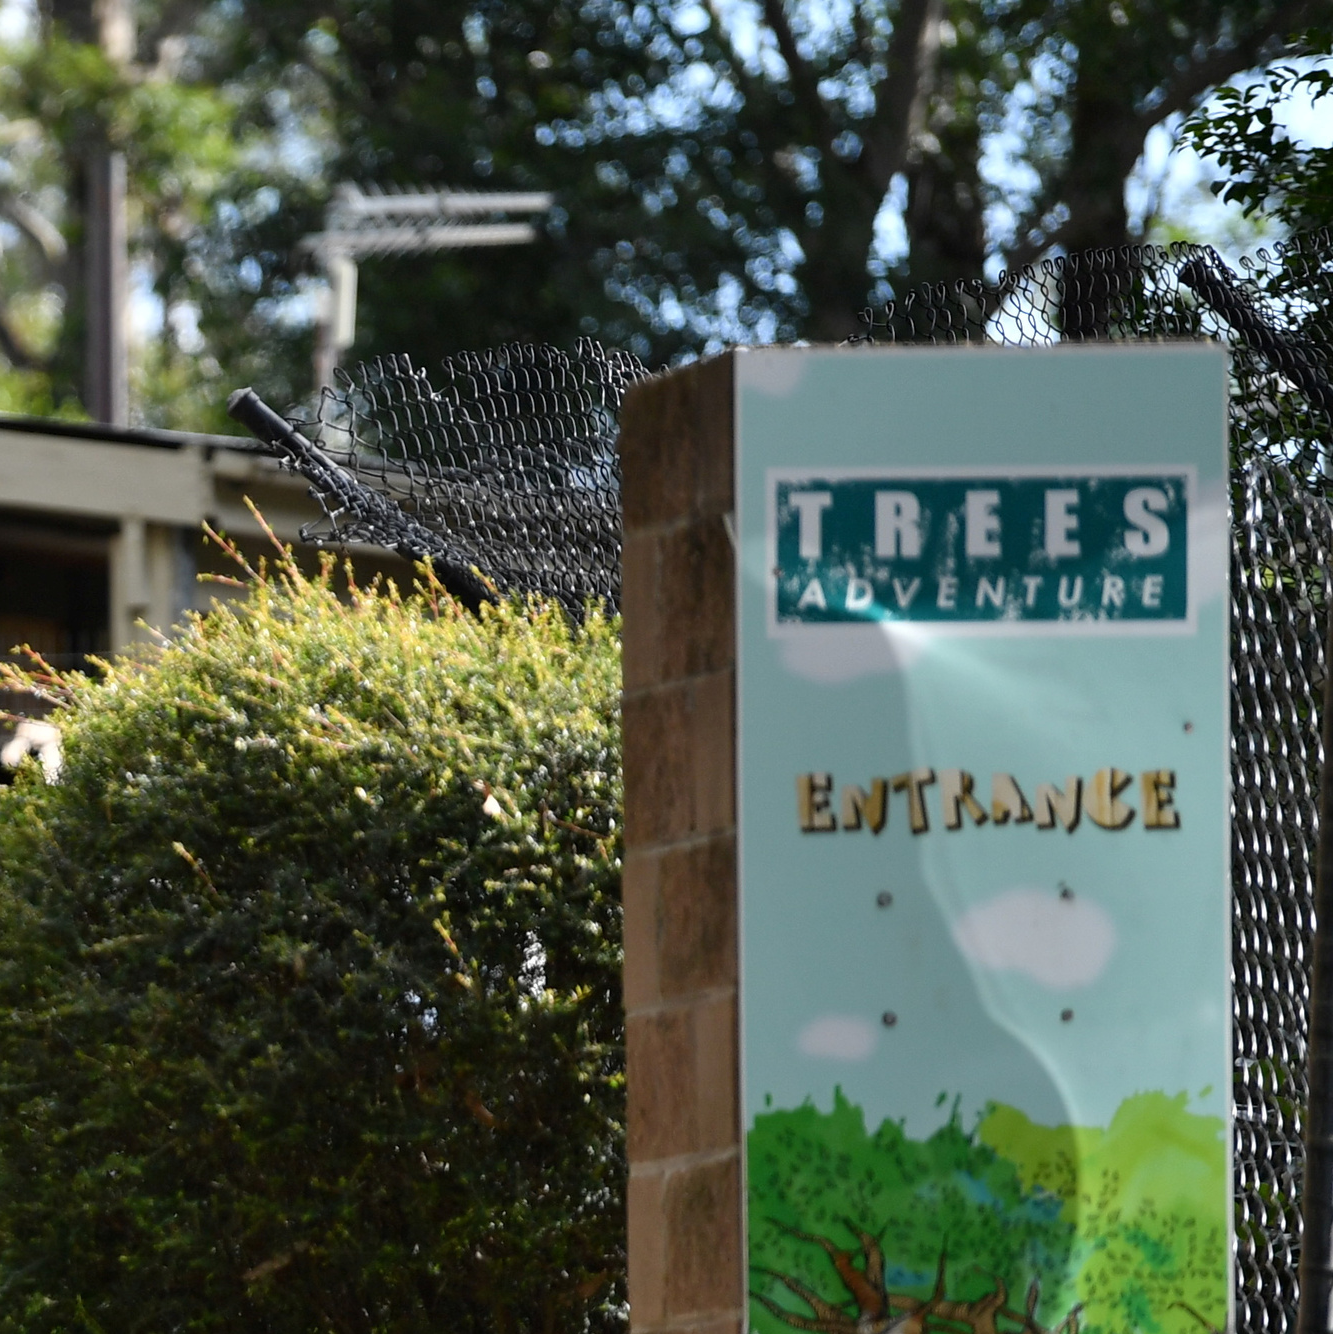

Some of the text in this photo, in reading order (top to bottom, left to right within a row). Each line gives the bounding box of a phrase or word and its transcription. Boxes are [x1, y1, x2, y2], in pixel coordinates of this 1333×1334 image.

[787, 487, 1171, 559] TREES
[796, 574, 1165, 610] ADVENTURE
[795, 766, 1181, 835] ENTRANCE
